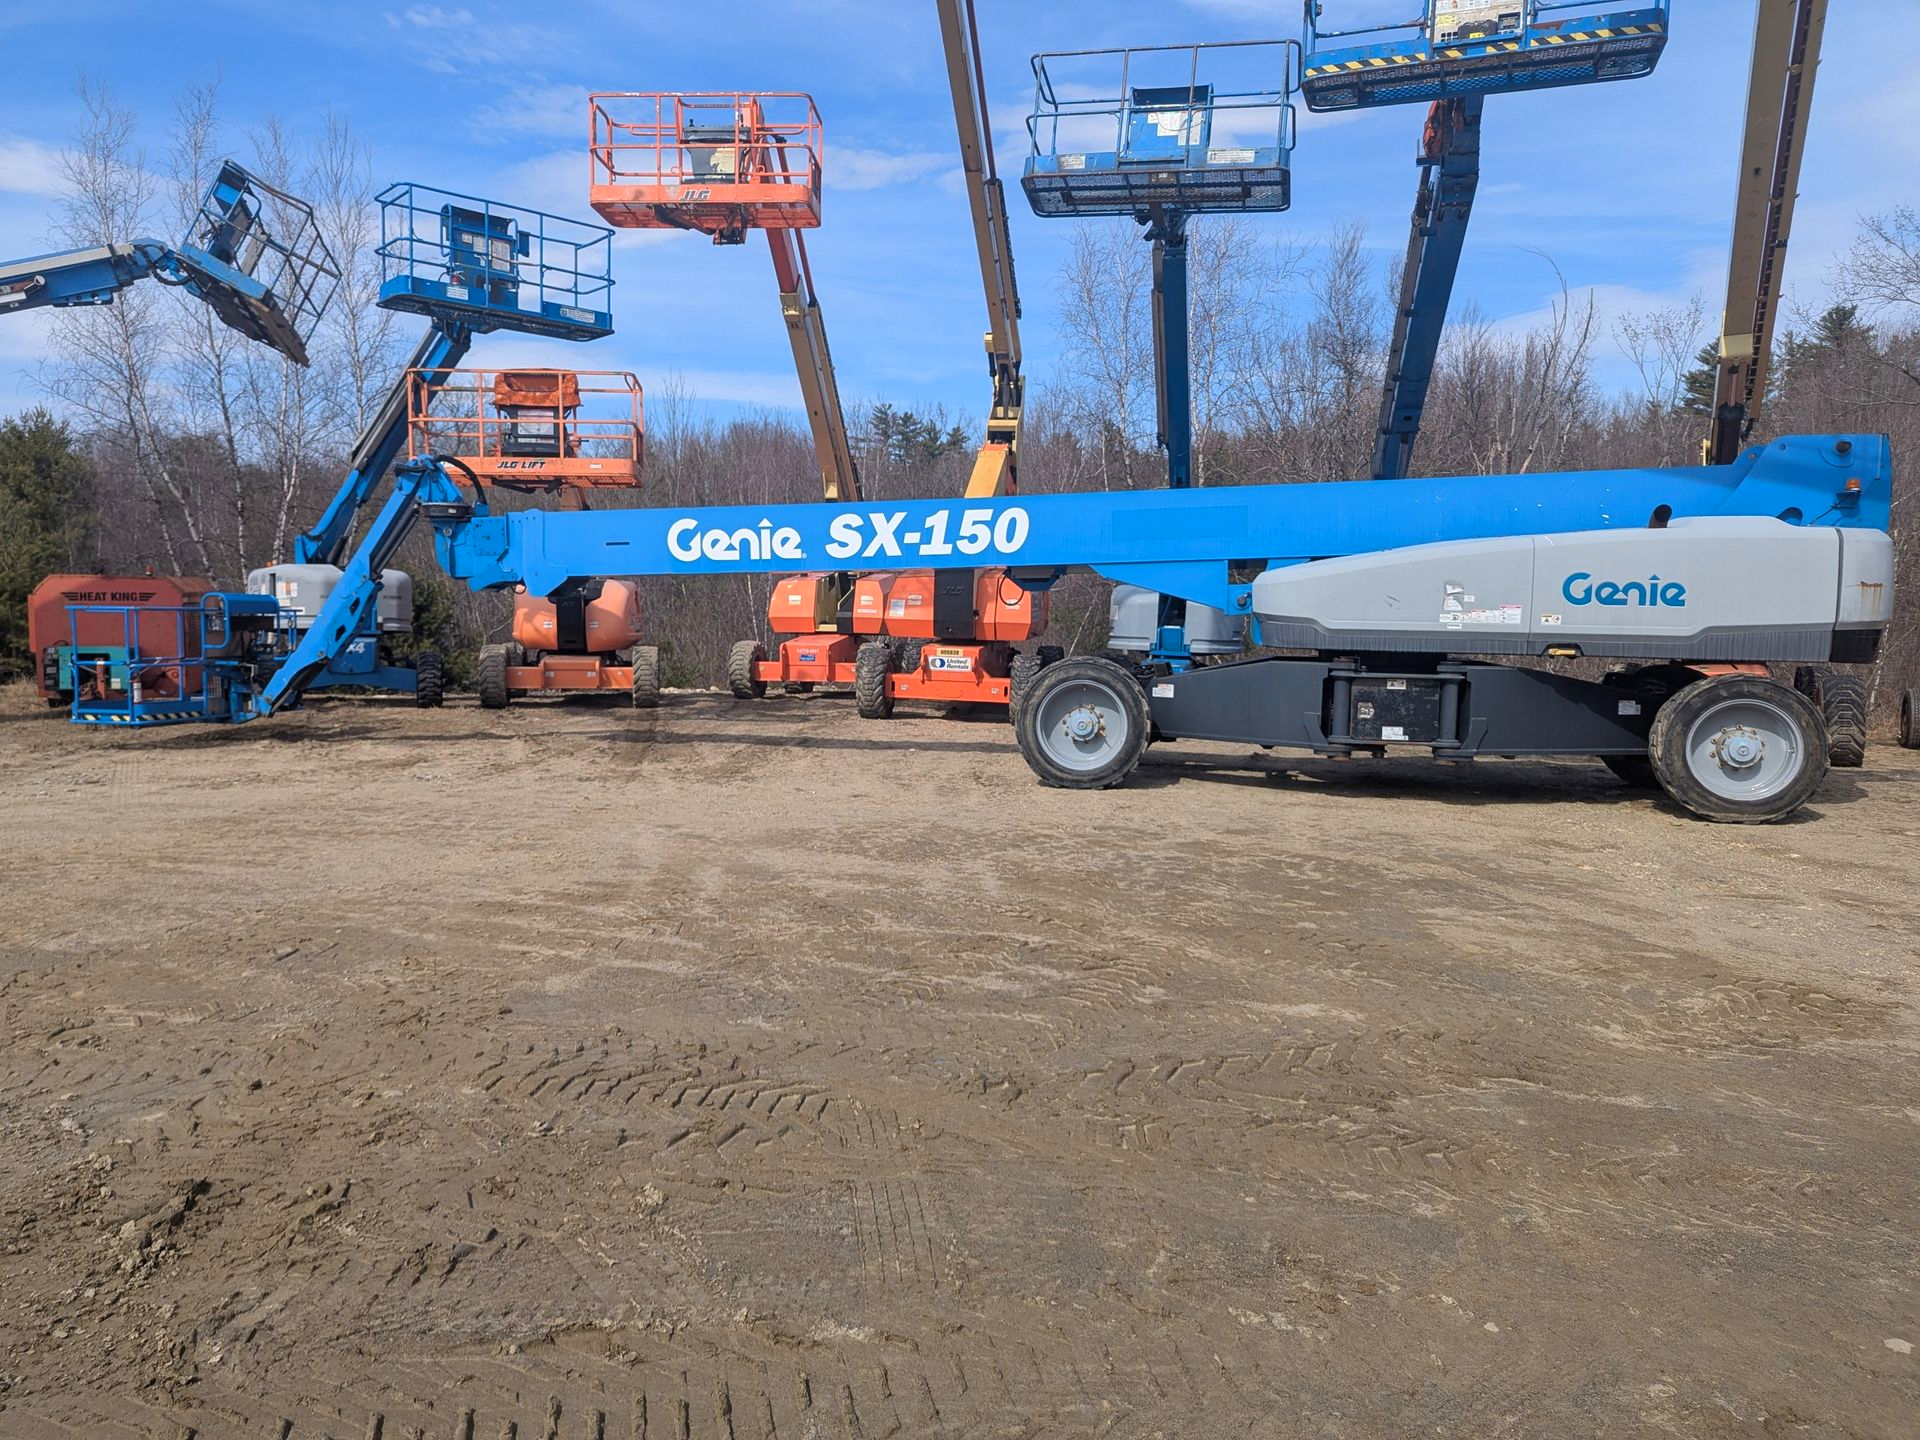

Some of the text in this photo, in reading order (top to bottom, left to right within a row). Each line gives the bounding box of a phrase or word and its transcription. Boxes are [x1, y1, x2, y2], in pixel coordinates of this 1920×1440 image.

[680, 190, 711, 201] JLG
[497, 461, 546, 469] JLG LIFT
[667, 507, 1029, 562] Genie SX-150
[1562, 572, 1687, 607] Genie
[79, 592, 138, 601] HEAT KING
